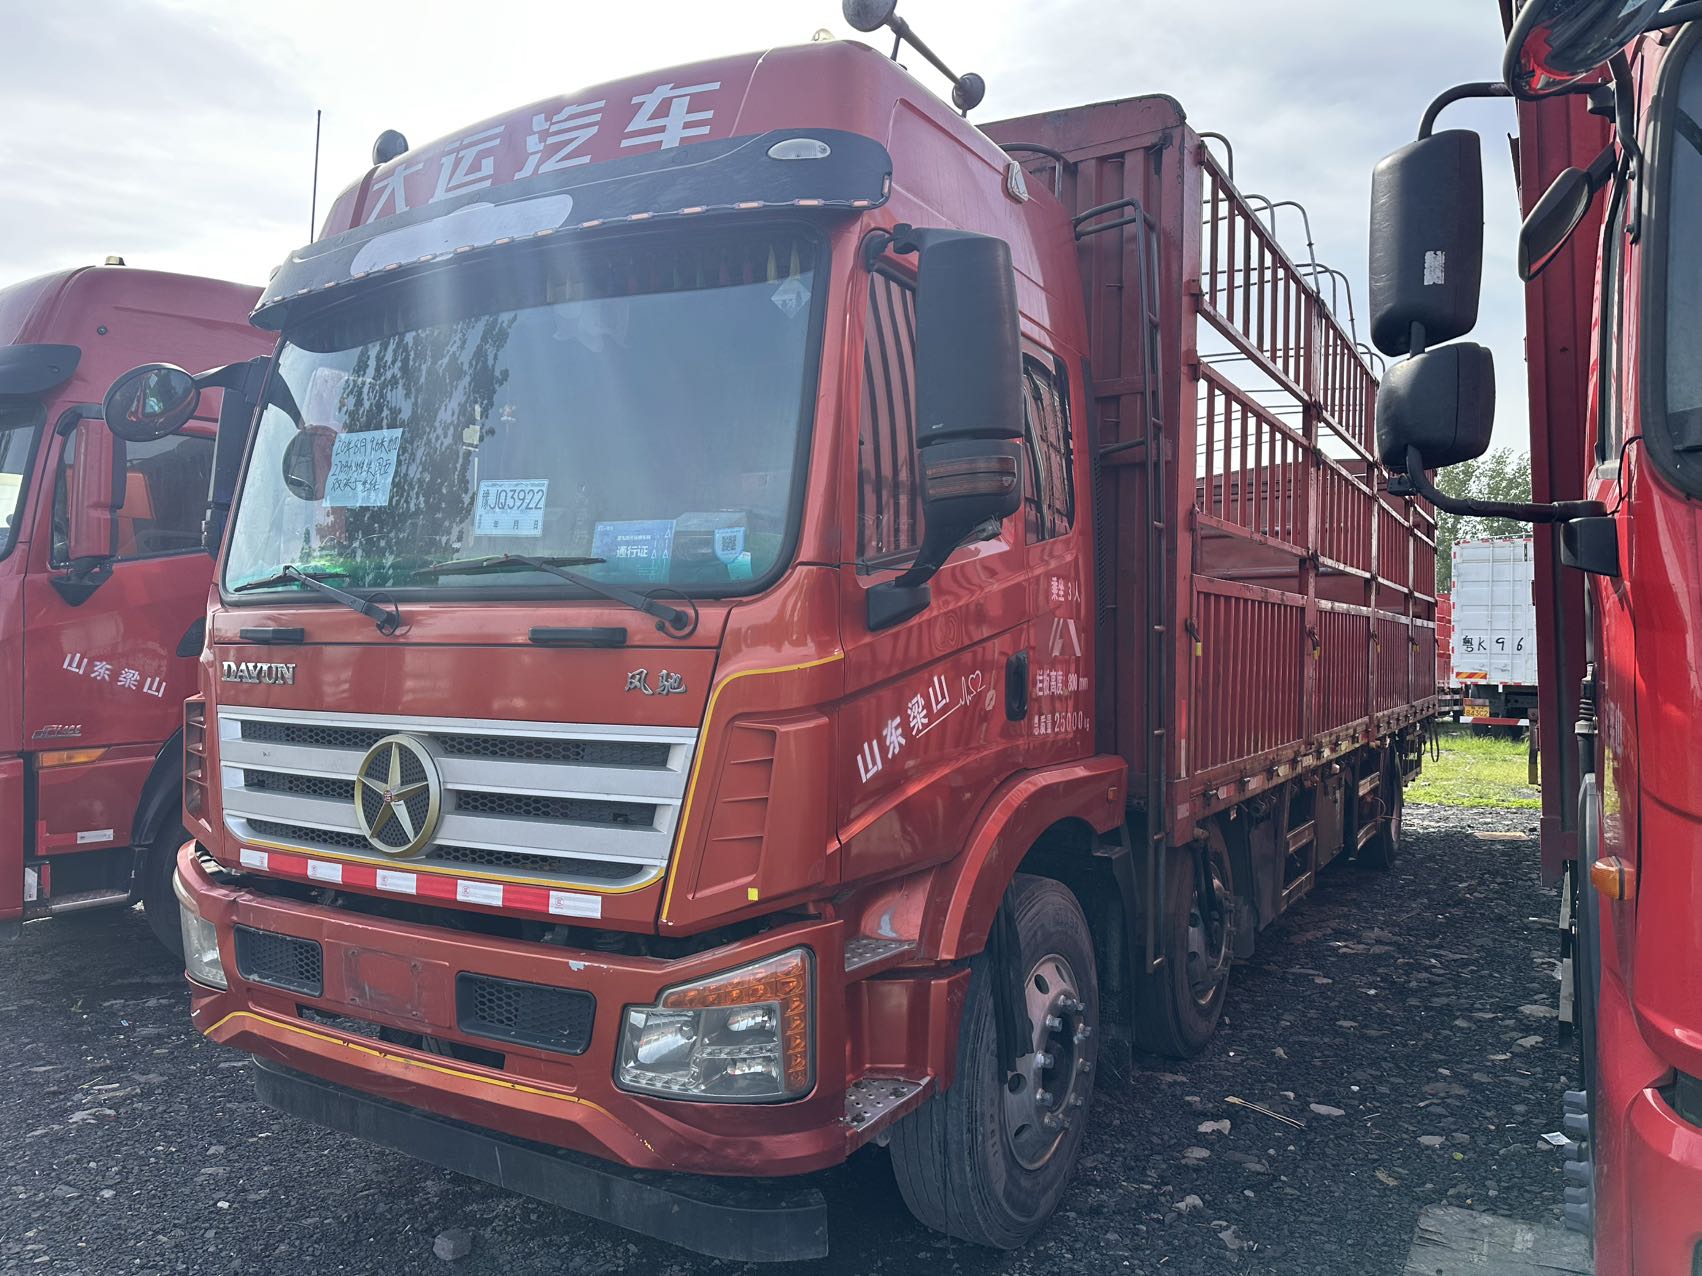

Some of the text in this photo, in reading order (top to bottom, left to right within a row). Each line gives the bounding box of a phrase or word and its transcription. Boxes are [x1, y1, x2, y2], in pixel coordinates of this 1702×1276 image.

[366, 82, 721, 224] 大运汽车
[481, 489, 544, 510] 豫JQ3922
[616, 545, 649, 558] 通行证
[62, 652, 167, 698] 山东梁山
[221, 661, 296, 685] DAYUN
[624, 668, 687, 696] 风驰
[856, 674, 950, 784] 山东梁山
